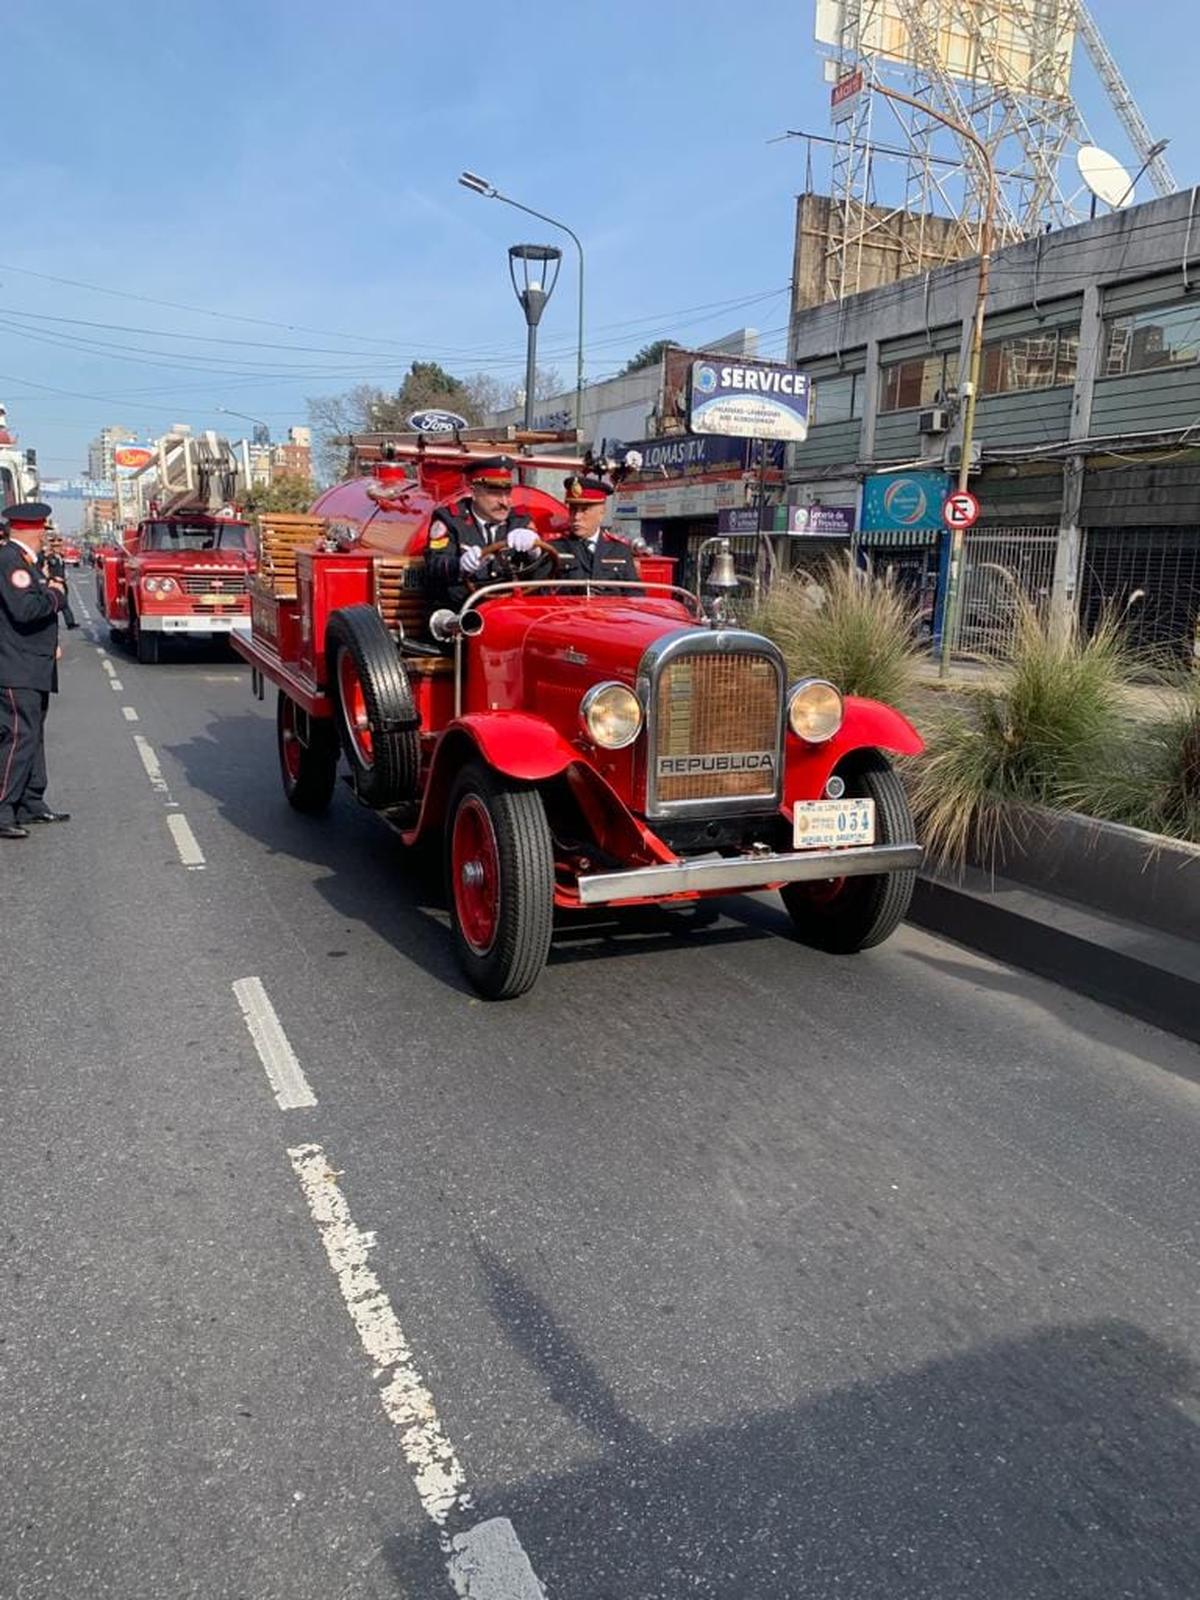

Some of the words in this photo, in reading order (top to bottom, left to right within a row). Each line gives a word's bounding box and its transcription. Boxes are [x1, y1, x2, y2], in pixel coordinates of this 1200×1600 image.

[721, 367, 806, 395] SERVICE
[421, 414, 456, 431] Ford
[645, 442, 685, 467] LOMAS
[952, 500, 967, 521] E
[660, 753, 774, 774] REPUBLICA
